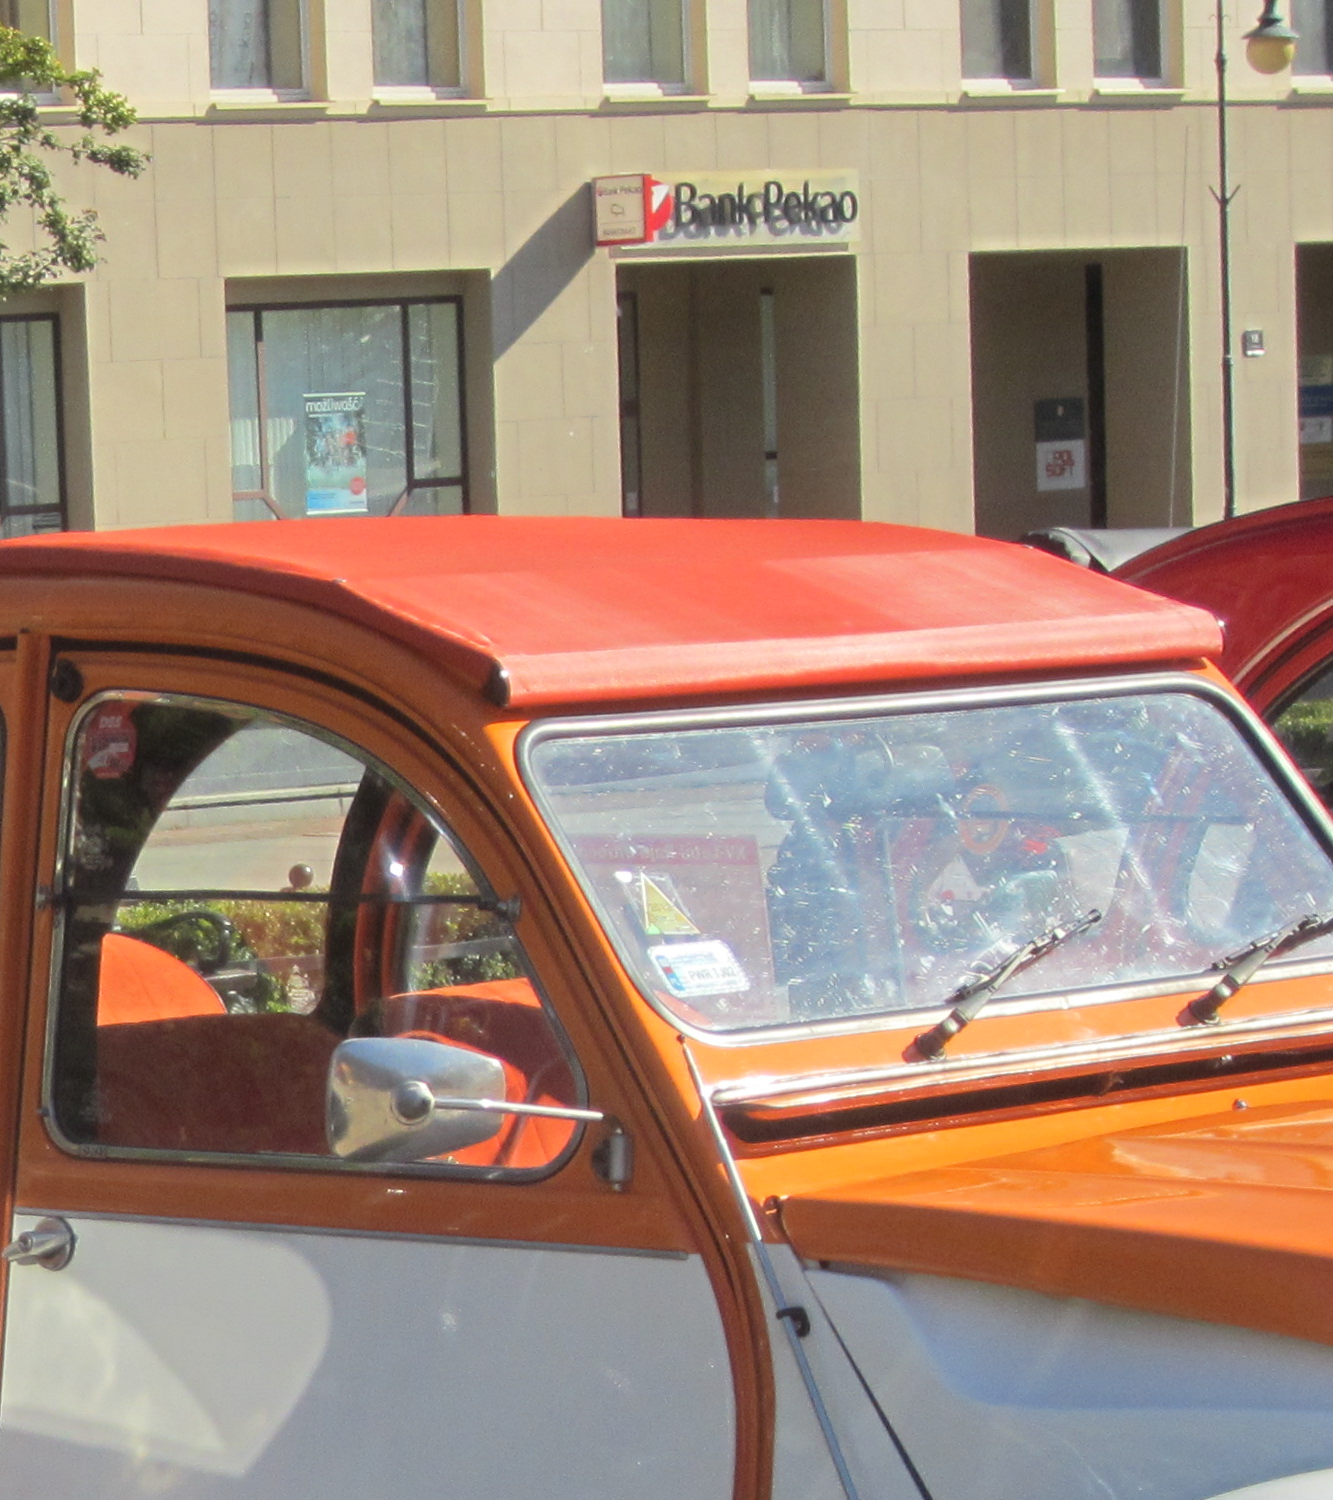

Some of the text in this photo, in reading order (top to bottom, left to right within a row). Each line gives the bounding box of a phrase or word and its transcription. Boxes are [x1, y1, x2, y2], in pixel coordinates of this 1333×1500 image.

[674, 180, 858, 227] Bank Pekao
[306, 397, 360, 412] możliwość
